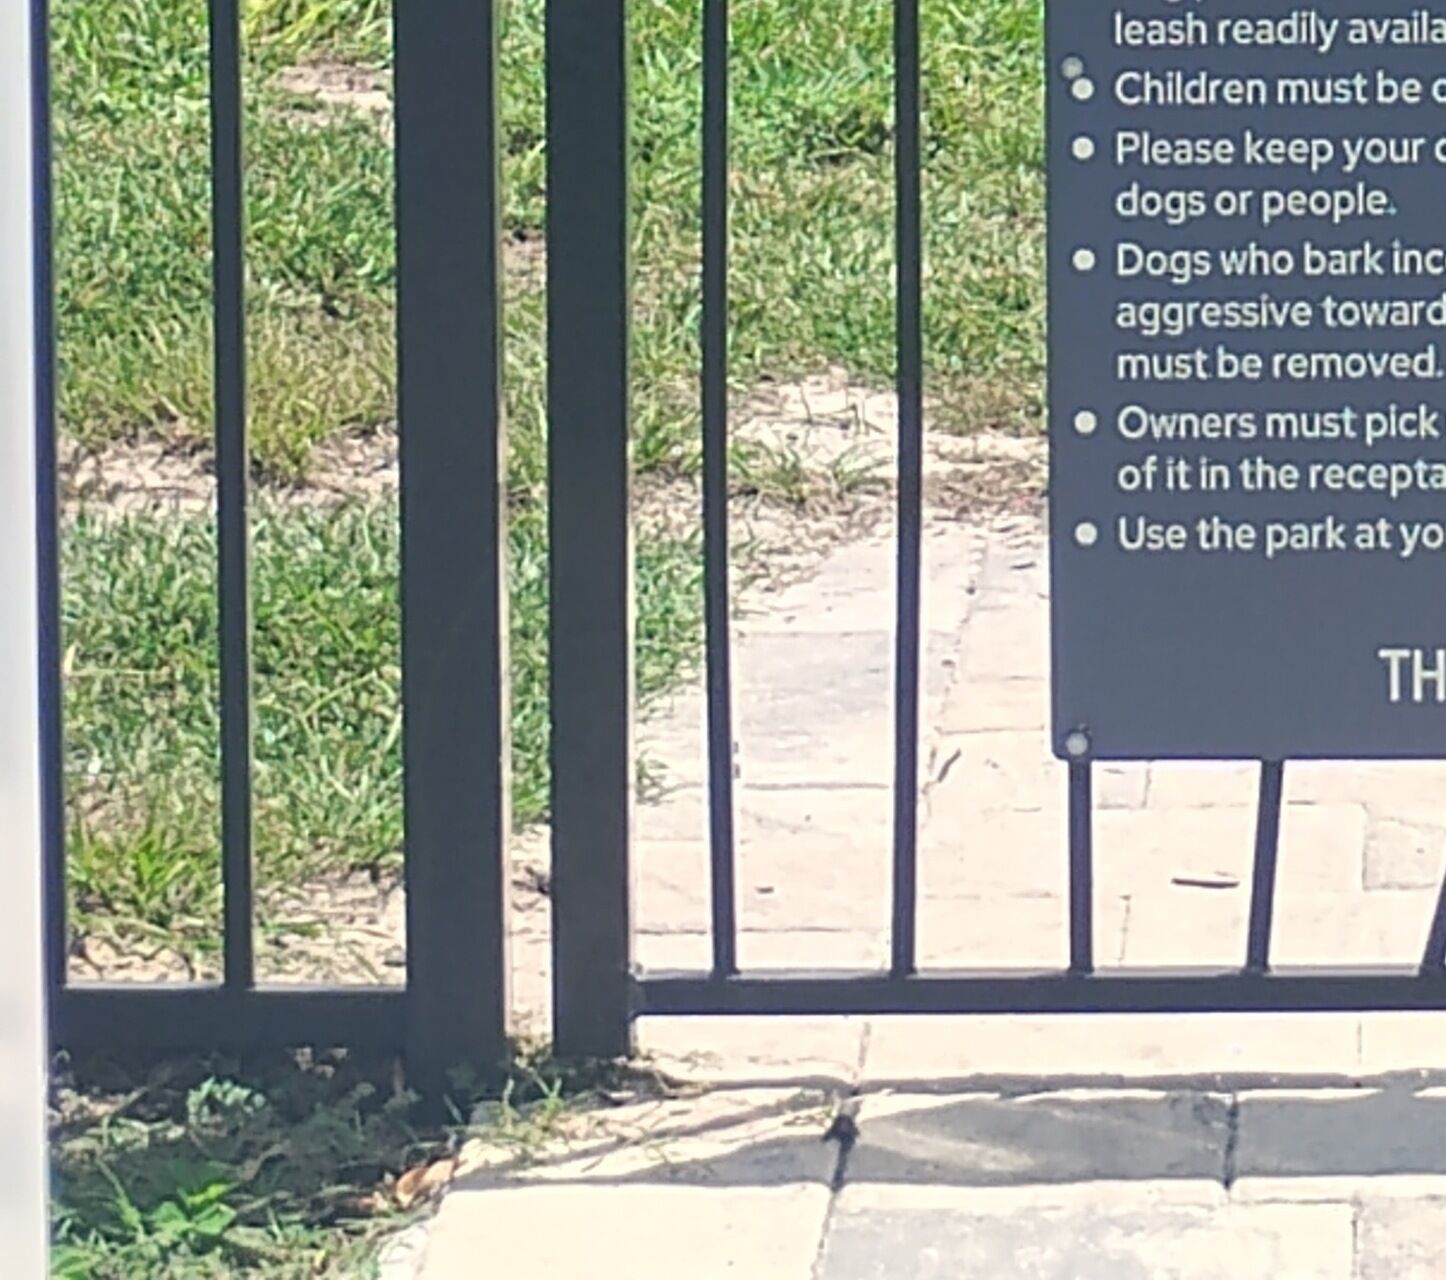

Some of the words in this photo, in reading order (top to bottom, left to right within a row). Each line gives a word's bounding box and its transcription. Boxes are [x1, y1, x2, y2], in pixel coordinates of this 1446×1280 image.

[1114, 10, 1208, 46] leash
[1217, 10, 1340, 53] readily
[1114, 70, 1267, 106] Children
[1277, 72, 1369, 105] must
[1376, 69, 1423, 104] be
[1116, 130, 1236, 166] Please
[1244, 129, 1334, 173] keep
[1341, 137, 1427, 173] your
[1115, 181, 1207, 225] dogs
[1214, 189, 1254, 216] or
[1262, 181, 1397, 225] people.
[1117, 242, 1212, 285] Dogs
[1219, 241, 1295, 276] who
[1303, 240, 1385, 276] bark
[1115, 292, 1313, 336] aggressive
[1117, 347, 1212, 381] must
[1216, 344, 1263, 380] be
[1272, 343, 1445, 380] removed.
[1117, 405, 1258, 441] Owners
[1265, 405, 1359, 439] must
[1365, 403, 1440, 447] pick
[1117, 454, 1158, 491] of
[1165, 455, 1192, 491] it
[1199, 455, 1231, 491] in
[1238, 455, 1301, 491] the
[1118, 515, 1188, 551] Use
[1195, 515, 1258, 551] the
[1265, 515, 1347, 559] park
[1353, 517, 1394, 550] at
